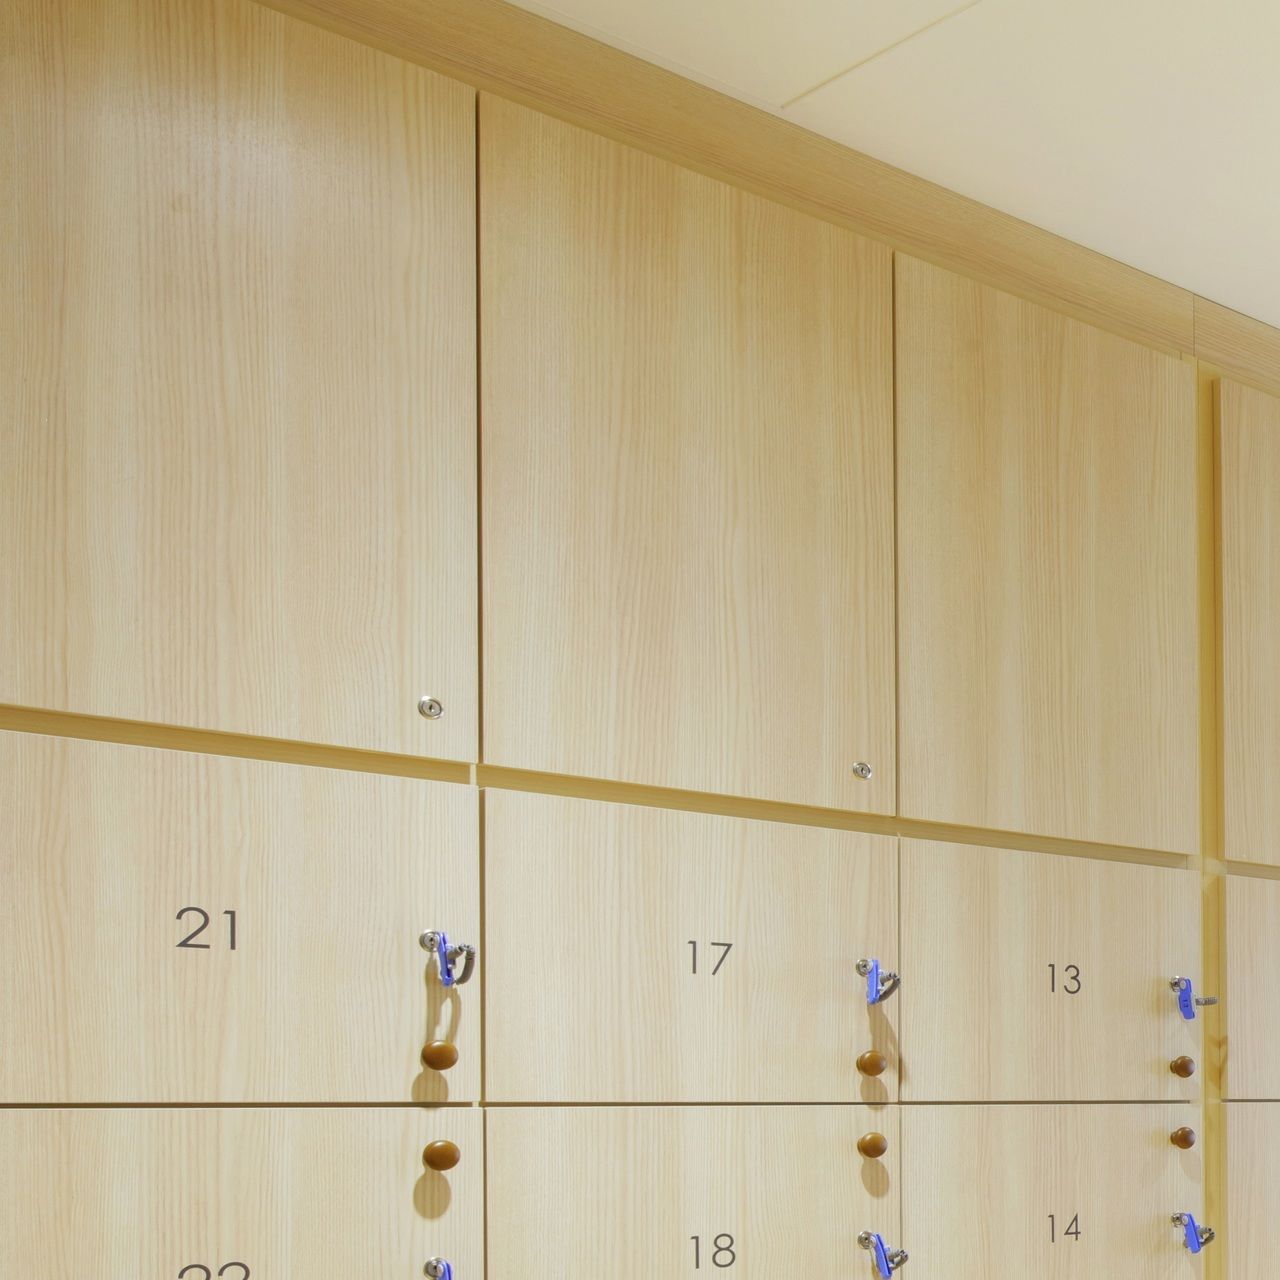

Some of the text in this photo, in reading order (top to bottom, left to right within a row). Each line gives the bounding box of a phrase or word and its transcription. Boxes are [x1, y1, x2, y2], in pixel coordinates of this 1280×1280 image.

[175, 906, 239, 951] 21
[687, 940, 734, 976] 17
[1047, 963, 1082, 995] 13
[1047, 1213, 1082, 1244] 14
[690, 1233, 736, 1270] 18
